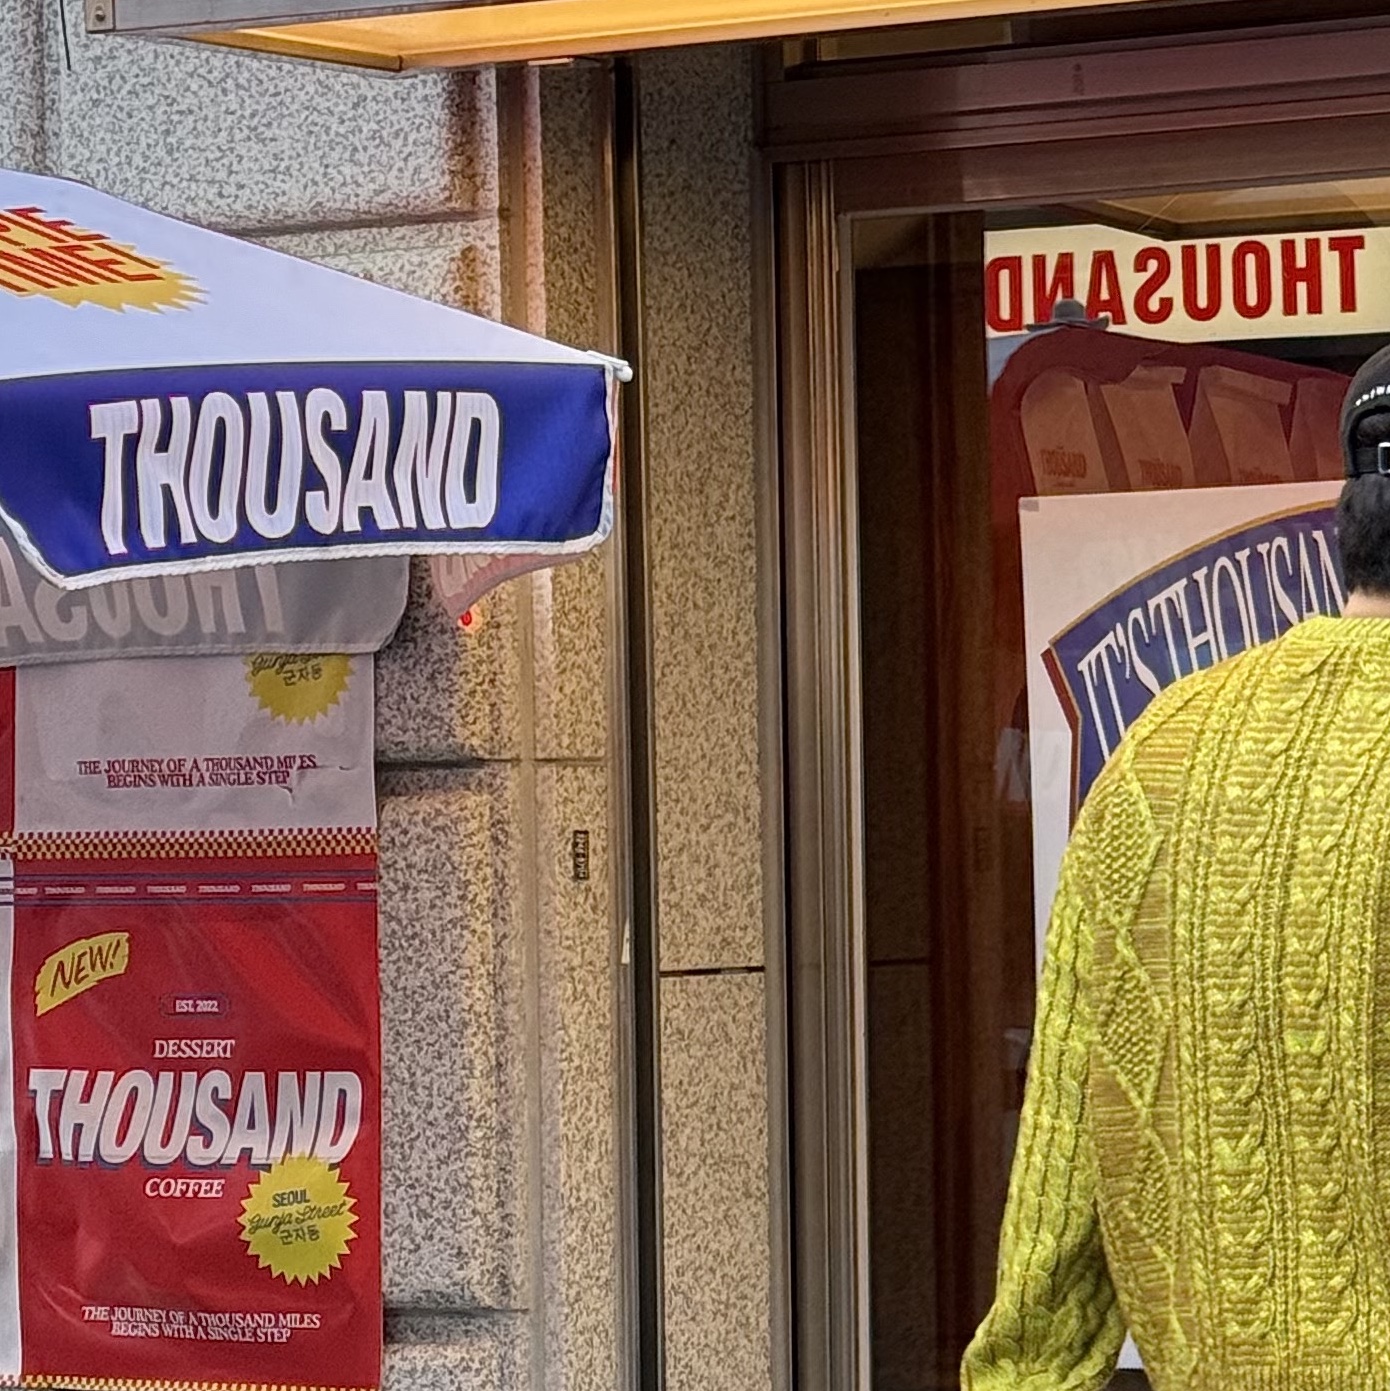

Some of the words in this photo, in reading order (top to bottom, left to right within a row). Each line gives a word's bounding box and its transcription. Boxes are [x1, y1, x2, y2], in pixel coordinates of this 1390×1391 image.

[89, 388, 499, 556] THOUSAND
[1077, 608, 1161, 761] IT'S
[77, 760, 101, 775] THE
[104, 758, 164, 774] JOURNEY
[166, 758, 187, 773] OF
[189, 757, 201, 773] A
[203, 756, 275, 772] THOUSAND
[107, 773, 156, 788] BEGINS
[158, 773, 193, 788] WITH
[198, 772, 208, 787] A
[209, 771, 254, 787] SINGLE
[256, 770, 290, 785] STEP
[50, 938, 121, 998] NEW!
[153, 1039, 235, 1059] DESSERT
[28, 1069, 362, 1167] THOUSAND
[145, 1178, 225, 1199] COFFEE
[272, 1188, 310, 1208] SEOUL
[81, 1306, 109, 1321] THE
[110, 1306, 167, 1323] JOURNEY
[168, 1310, 187, 1324] OF
[188, 1311, 199, 1325] A
[199, 1312, 275, 1328] THOUSAND
[278, 1313, 321, 1329] MILES
[111, 1321, 159, 1337] BEGINS
[161, 1323, 195, 1339] WITH
[196, 1326, 206, 1340] A
[207, 1326, 253, 1342] SINGLE
[256, 1327, 291, 1343] STEP
